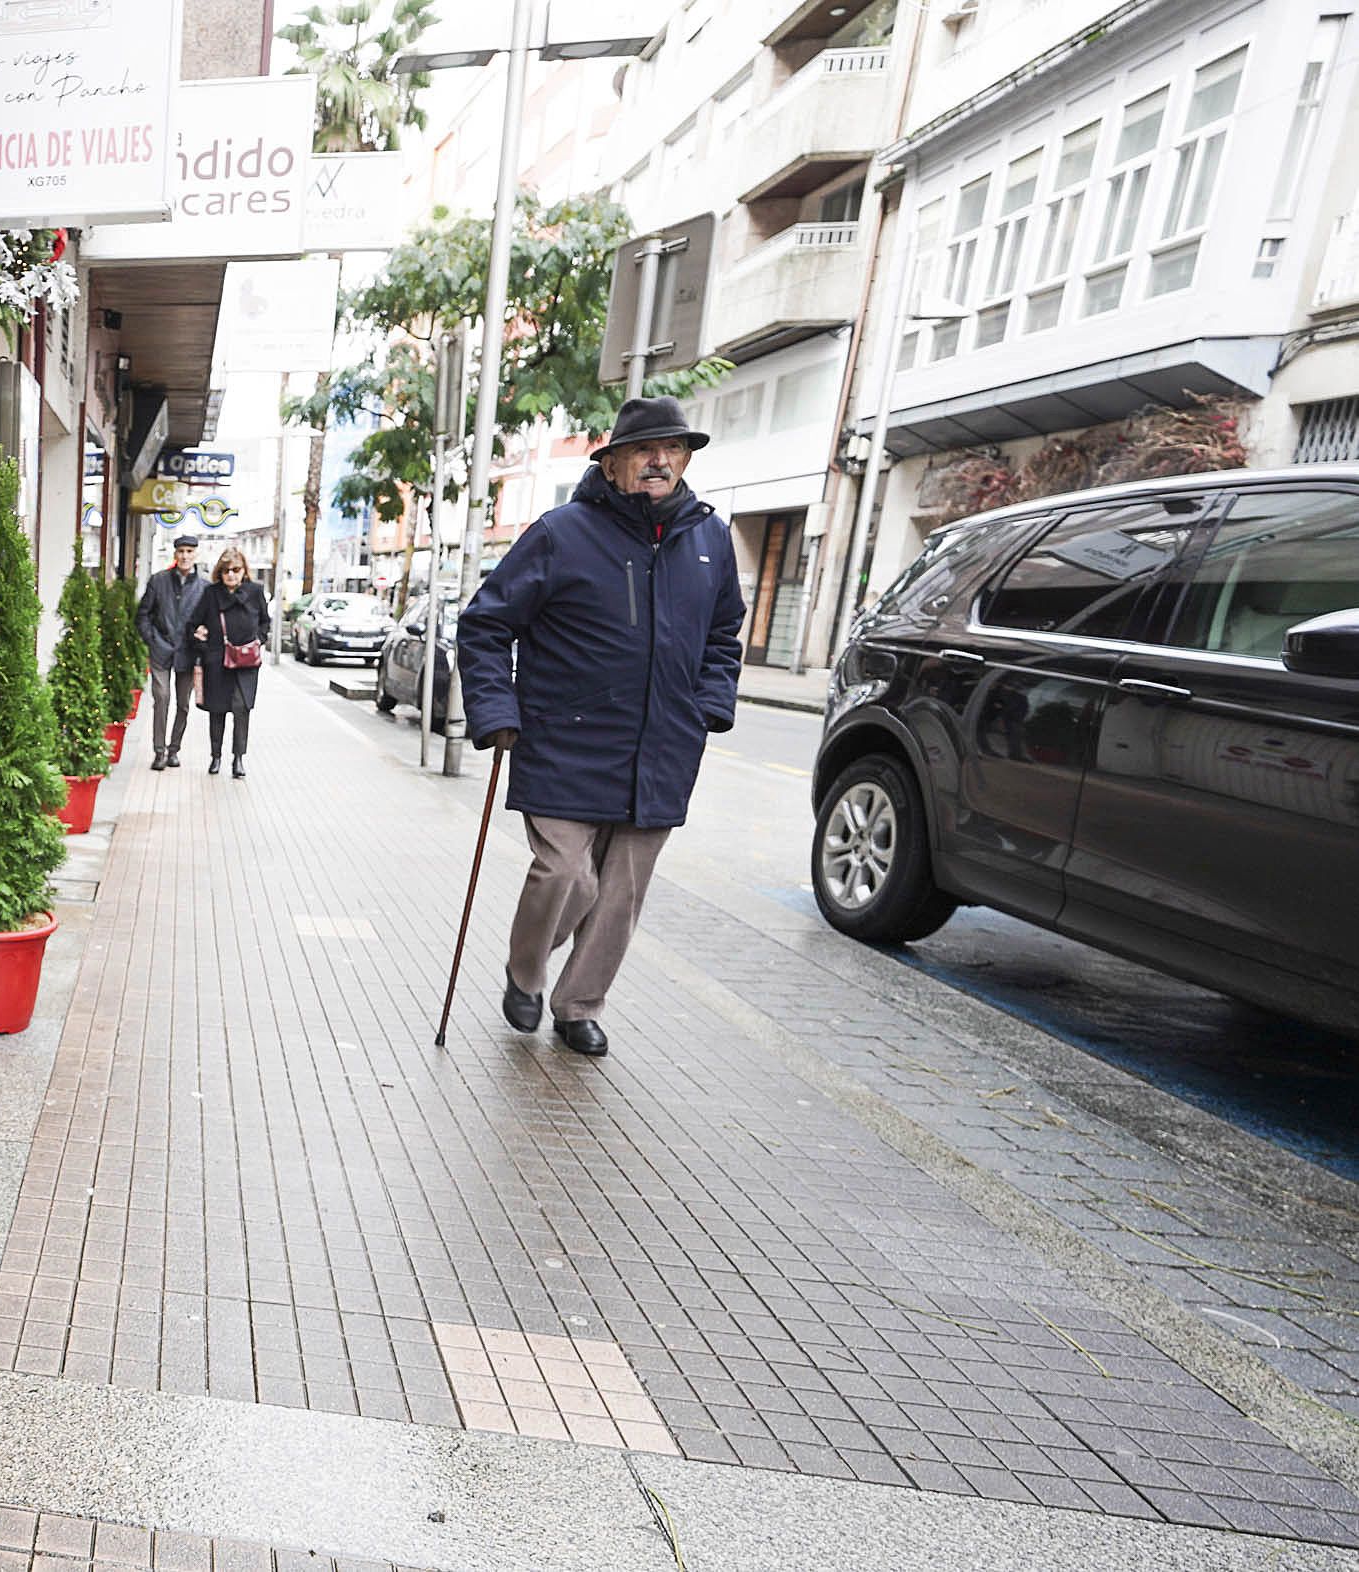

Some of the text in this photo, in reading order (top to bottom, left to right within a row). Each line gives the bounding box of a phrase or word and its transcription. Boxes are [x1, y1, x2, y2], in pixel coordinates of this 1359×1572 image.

[13, 50, 80, 85] viajes
[4, 67, 149, 107] con Pancho
[47, 129, 74, 167] DE
[82, 123, 154, 166] VIAJES
[27, 175, 68, 188] XG705
